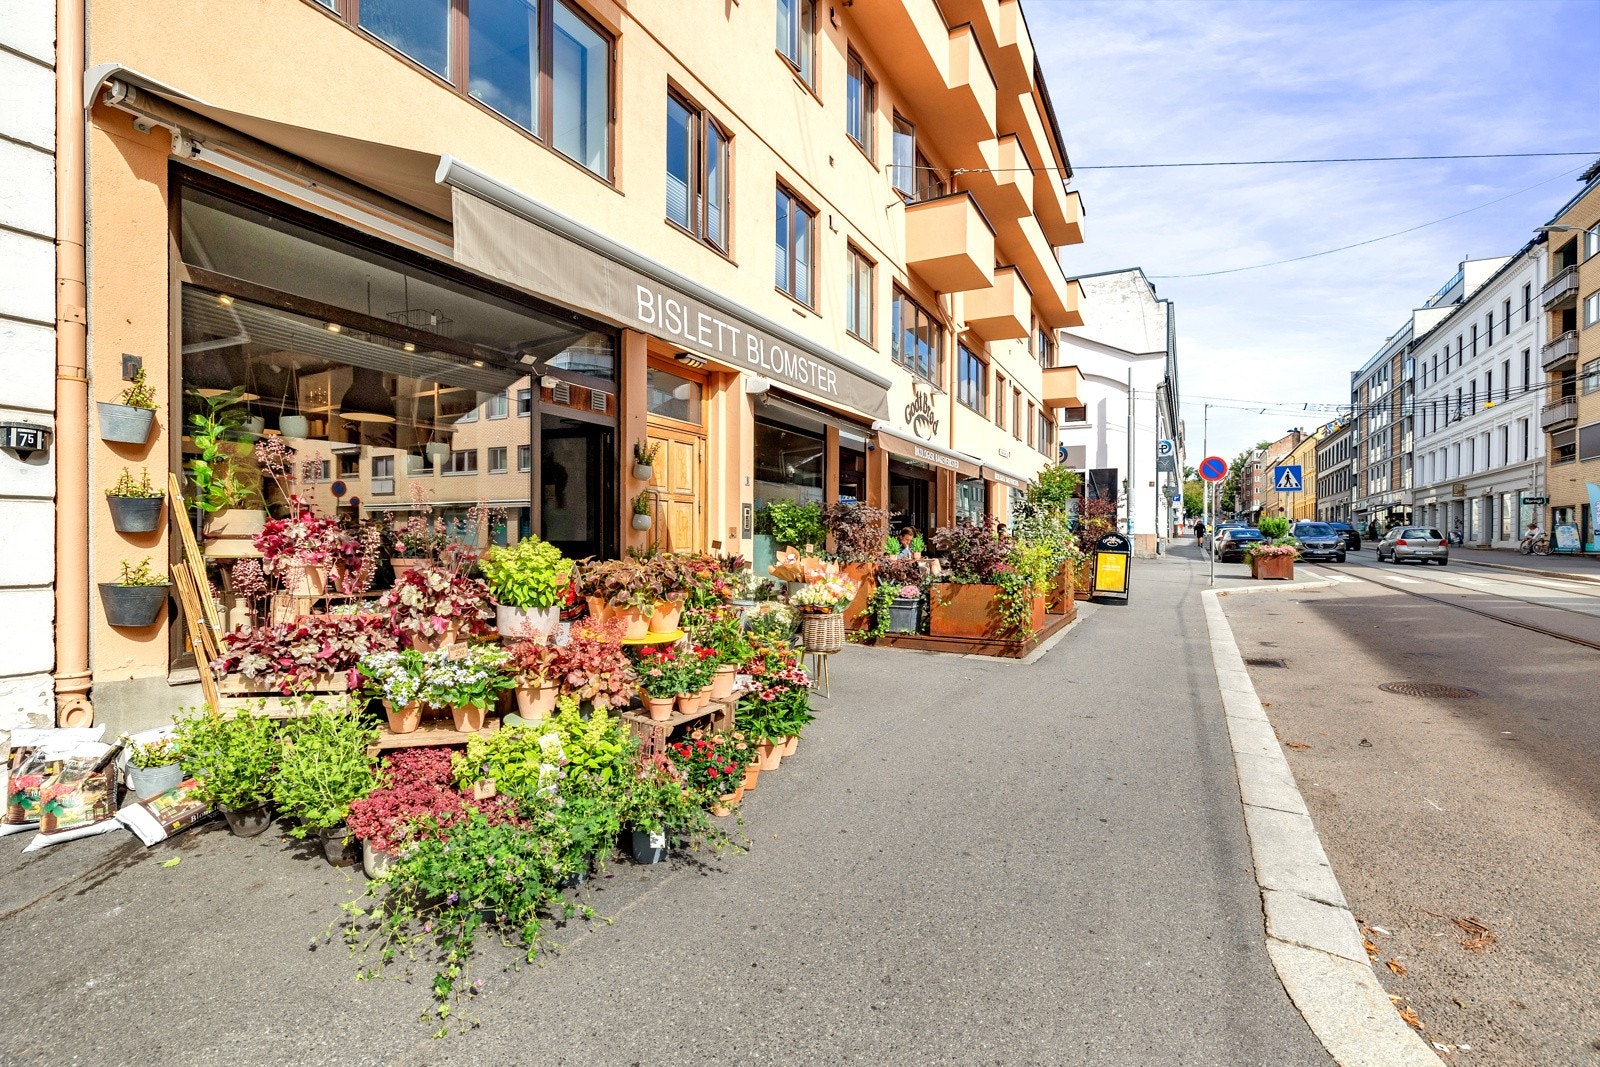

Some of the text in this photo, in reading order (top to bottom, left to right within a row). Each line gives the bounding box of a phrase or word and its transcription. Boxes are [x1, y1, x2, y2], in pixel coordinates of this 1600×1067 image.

[637, 284, 837, 395] BISLETT BLOMSTER
[905, 390, 922, 425] Godt
[19, 433, 34, 447] 75
